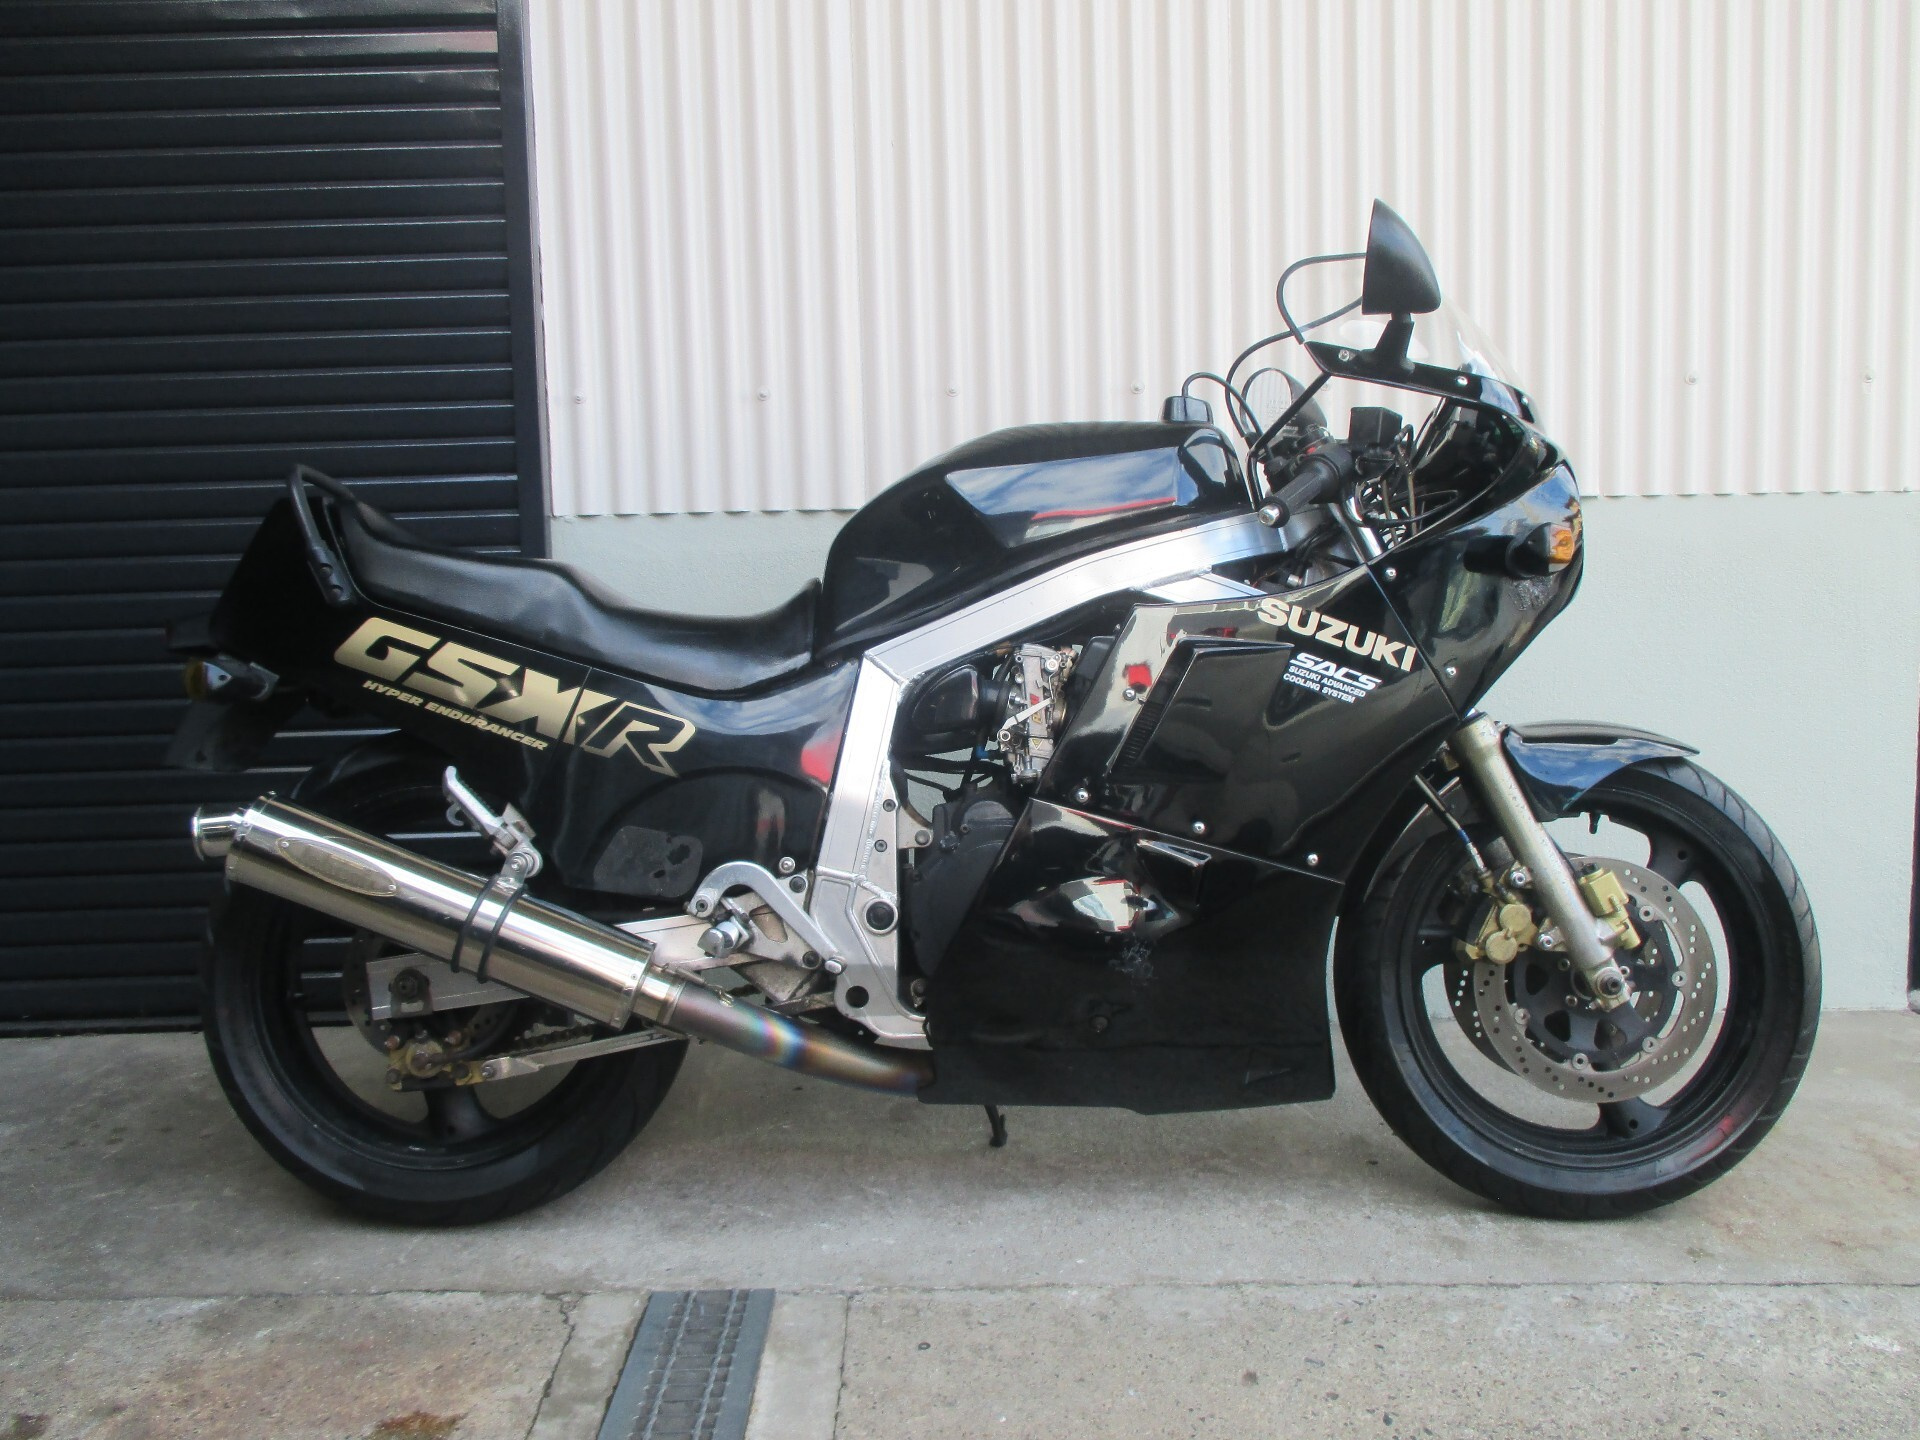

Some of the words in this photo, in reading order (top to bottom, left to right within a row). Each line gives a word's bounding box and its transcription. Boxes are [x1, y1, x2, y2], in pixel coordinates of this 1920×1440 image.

[1257, 598, 1417, 672] SUZUKI
[1283, 673, 1320, 691] COOLING
[1322, 686, 1356, 704] SYSTEM
[1288, 665, 1321, 681] SUZUKI
[1321, 677, 1366, 697] ADVANCED
[1289, 652, 1382, 690] SACS
[362, 680, 424, 706] HYPER
[424, 701, 549, 751] ENDURANCER
